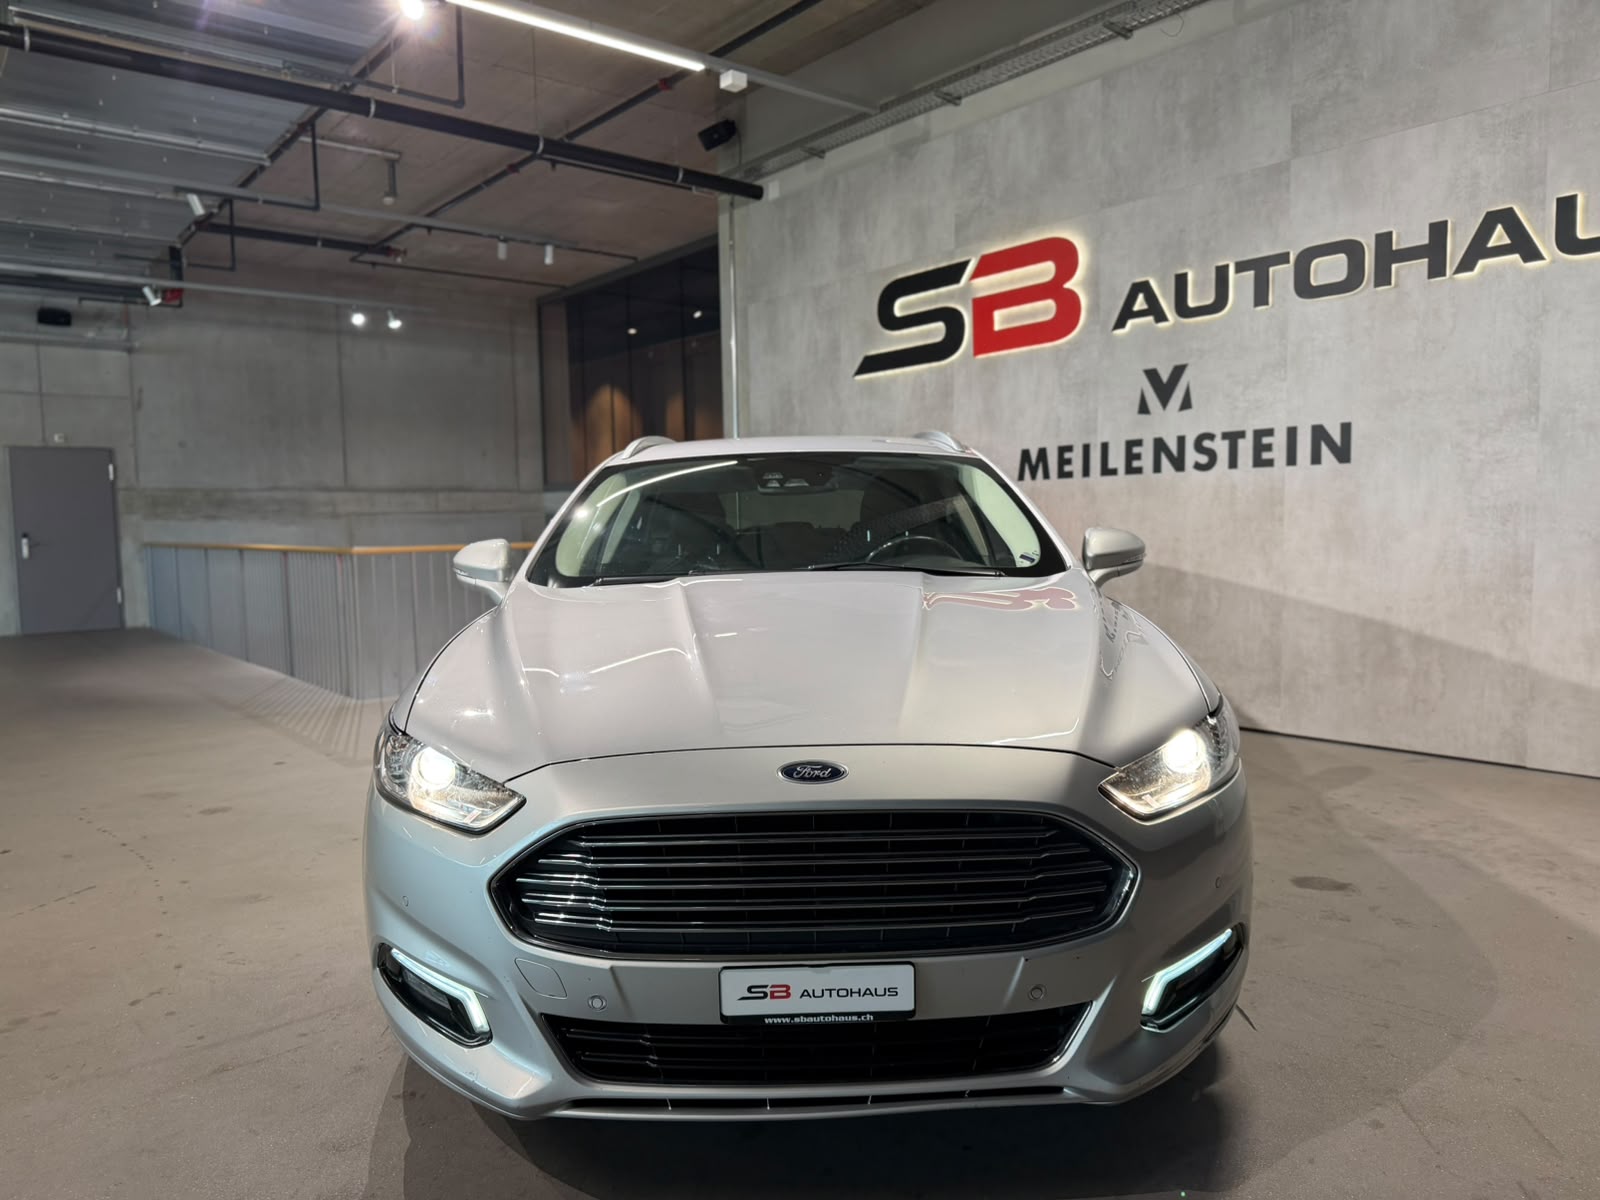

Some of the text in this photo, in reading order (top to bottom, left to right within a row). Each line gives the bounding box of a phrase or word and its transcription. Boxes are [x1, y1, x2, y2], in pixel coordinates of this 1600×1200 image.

[853, 236, 1082, 379] SB
[1018, 422, 1353, 481] MEILENSTEIN
[793, 765, 831, 778] Ford
[737, 984, 898, 1001] SB AUTOHAUS
[764, 1013, 874, 1024] www.sbautohaus.ch
